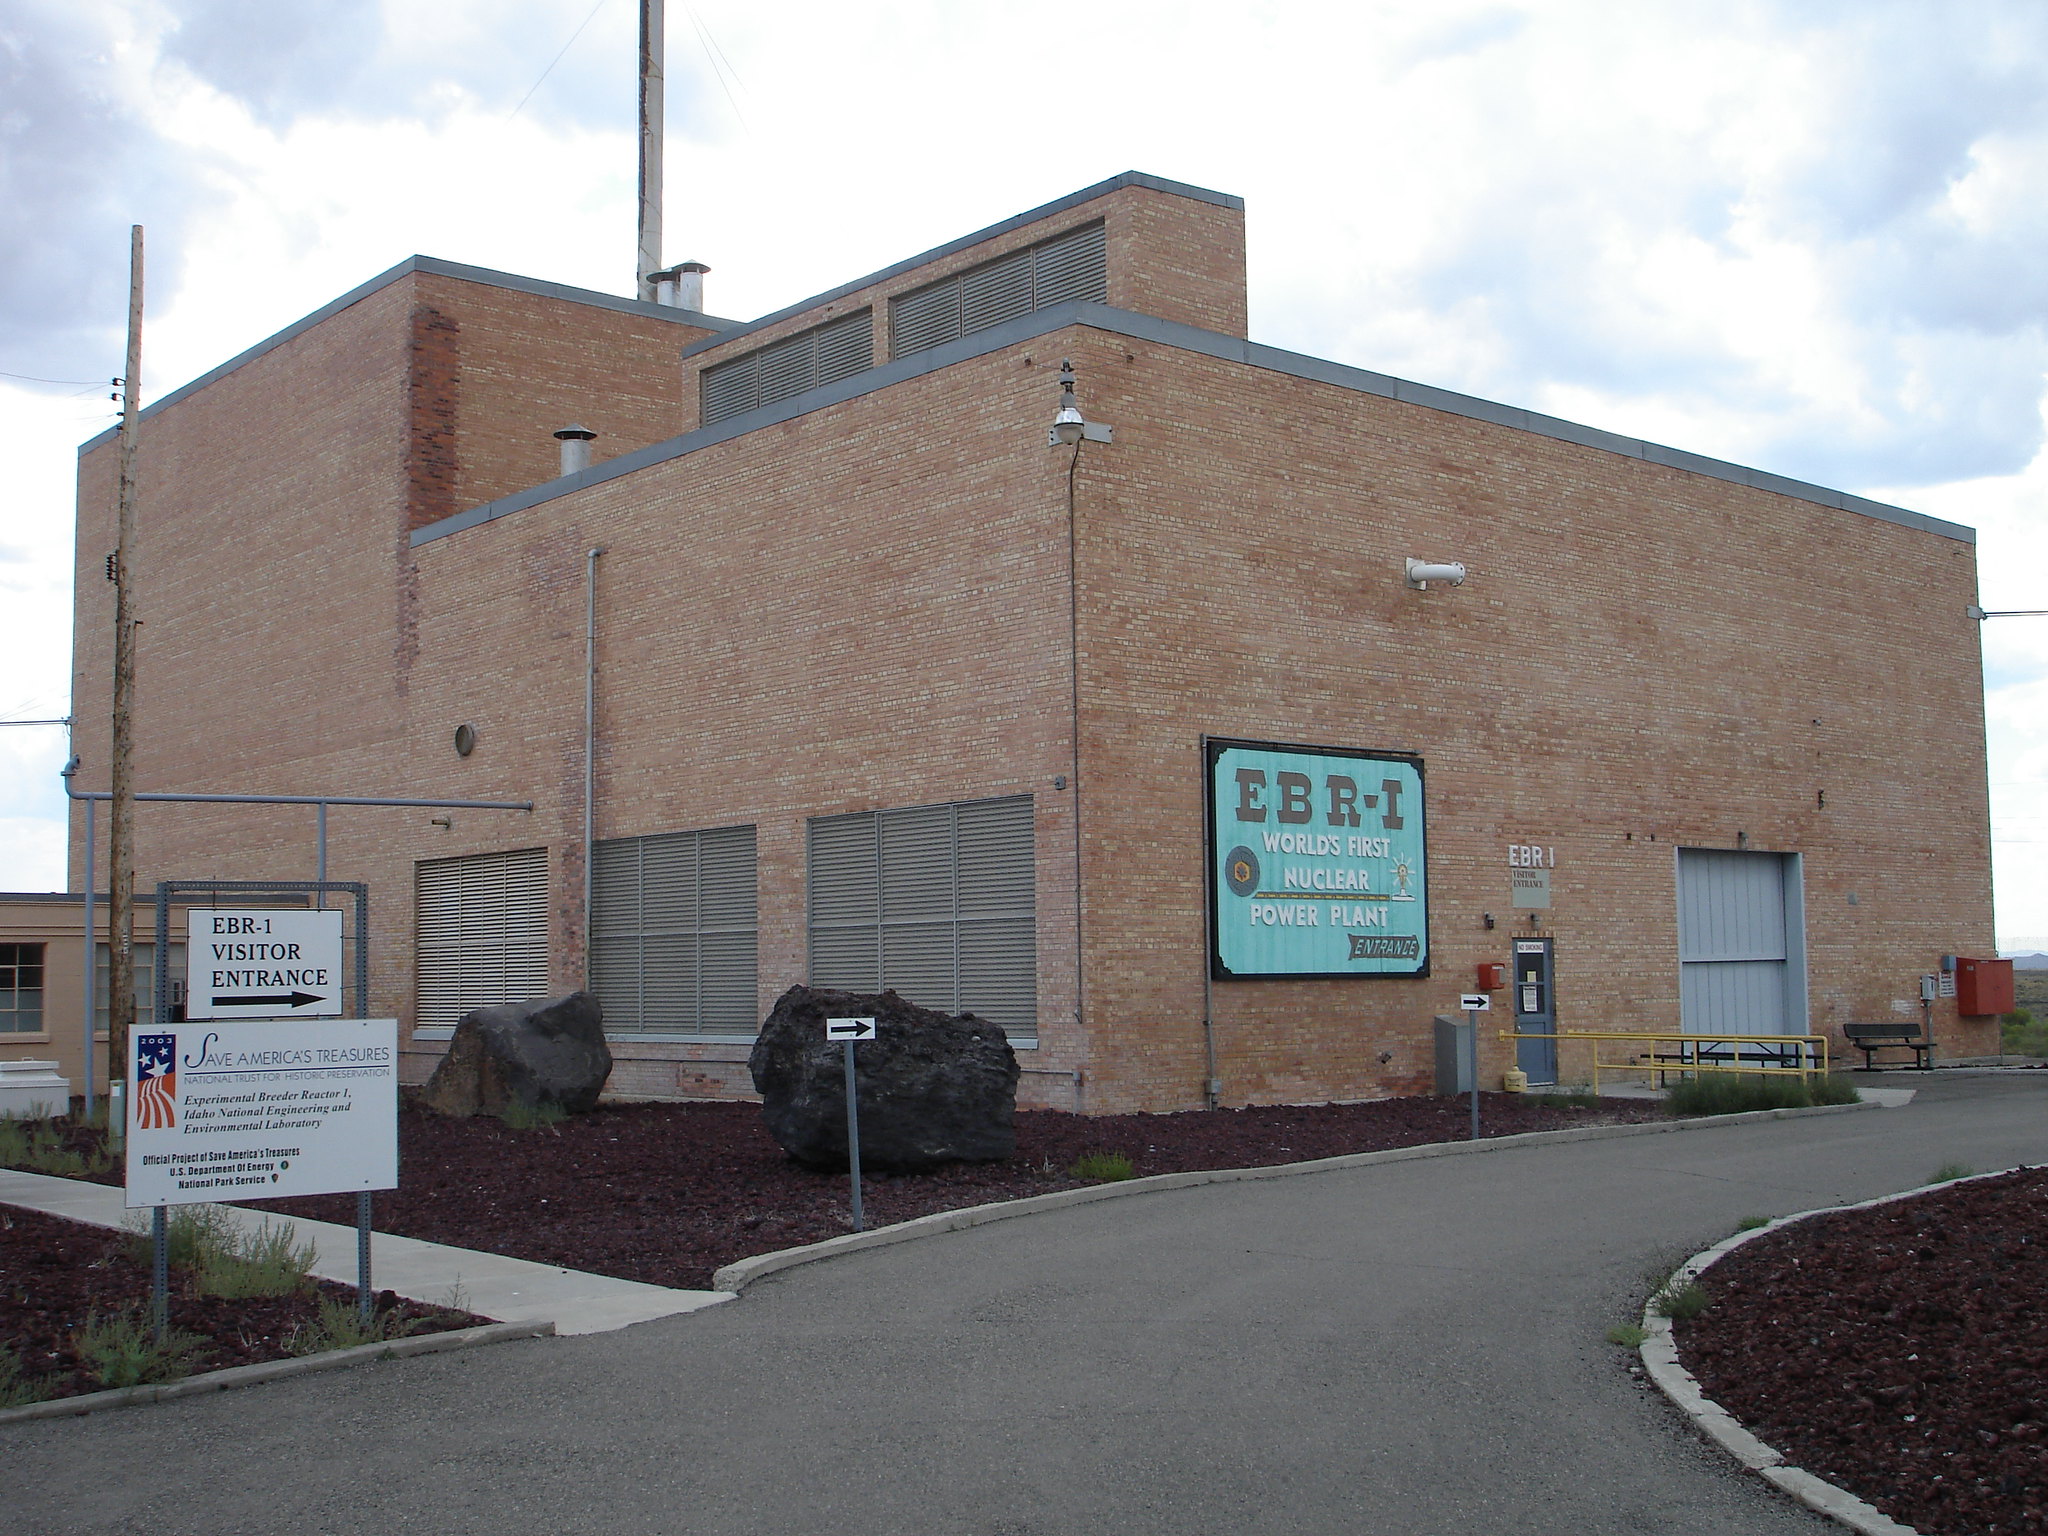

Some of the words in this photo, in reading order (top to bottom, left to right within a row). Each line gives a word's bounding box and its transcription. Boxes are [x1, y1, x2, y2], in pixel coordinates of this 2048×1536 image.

[1262, 831, 1341, 856] WORLD'S
[1347, 836, 1390, 859] FIRST
[1508, 845, 1543, 867] EBR
[1284, 867, 1370, 890] NUCLEAR
[1512, 870, 1537, 879] VISITOR
[1513, 879, 1544, 888] ENTRANCE
[1250, 904, 1319, 927] POWER
[1330, 905, 1389, 927] PLANT
[212, 917, 272, 935] EBR-1
[212, 943, 301, 961] VISITOR
[1354, 938, 1418, 956] ENTRANCE
[212, 969, 328, 988] ENTRANCE
[141, 1037, 173, 1045] 2003
[184, 1032, 233, 1069] SAVE
[237, 1050, 312, 1066] AMERICA'S
[316, 1047, 390, 1063] TREASURES
[184, 1075, 232, 1085] NATIONAL
[234, 1073, 261, 1083] TRUST
[263, 1072, 281, 1082] FOR
[285, 1070, 325, 1081] HISTORIC
[327, 1068, 390, 1080] PRESERVATION
[184, 1092, 256, 1107] Experimental
[258, 1091, 299, 1102] Breeder
[301, 1089, 341, 1100] Reactor
[184, 1108, 216, 1120] Idaho
[217, 1106, 265, 1119] National
[266, 1103, 330, 1117] Engineering
[331, 1102, 352, 1112] and
[184, 1120, 264, 1135] Environmental
[265, 1119, 322, 1130] Laboratory
[143, 1153, 171, 1165] Official
[172, 1151, 199, 1164] Project
[209, 1150, 227, 1162] Save
[227, 1148, 264, 1161] America's
[265, 1147, 300, 1158] Treasures
[170, 1167, 186, 1176] U.S.
[188, 1164, 236, 1176] Department
[237, 1163, 246, 1172] Of
[247, 1161, 275, 1172] Energy
[178, 1178, 213, 1189] National
[215, 1177, 234, 1187] Park
[235, 1175, 266, 1185] Service
